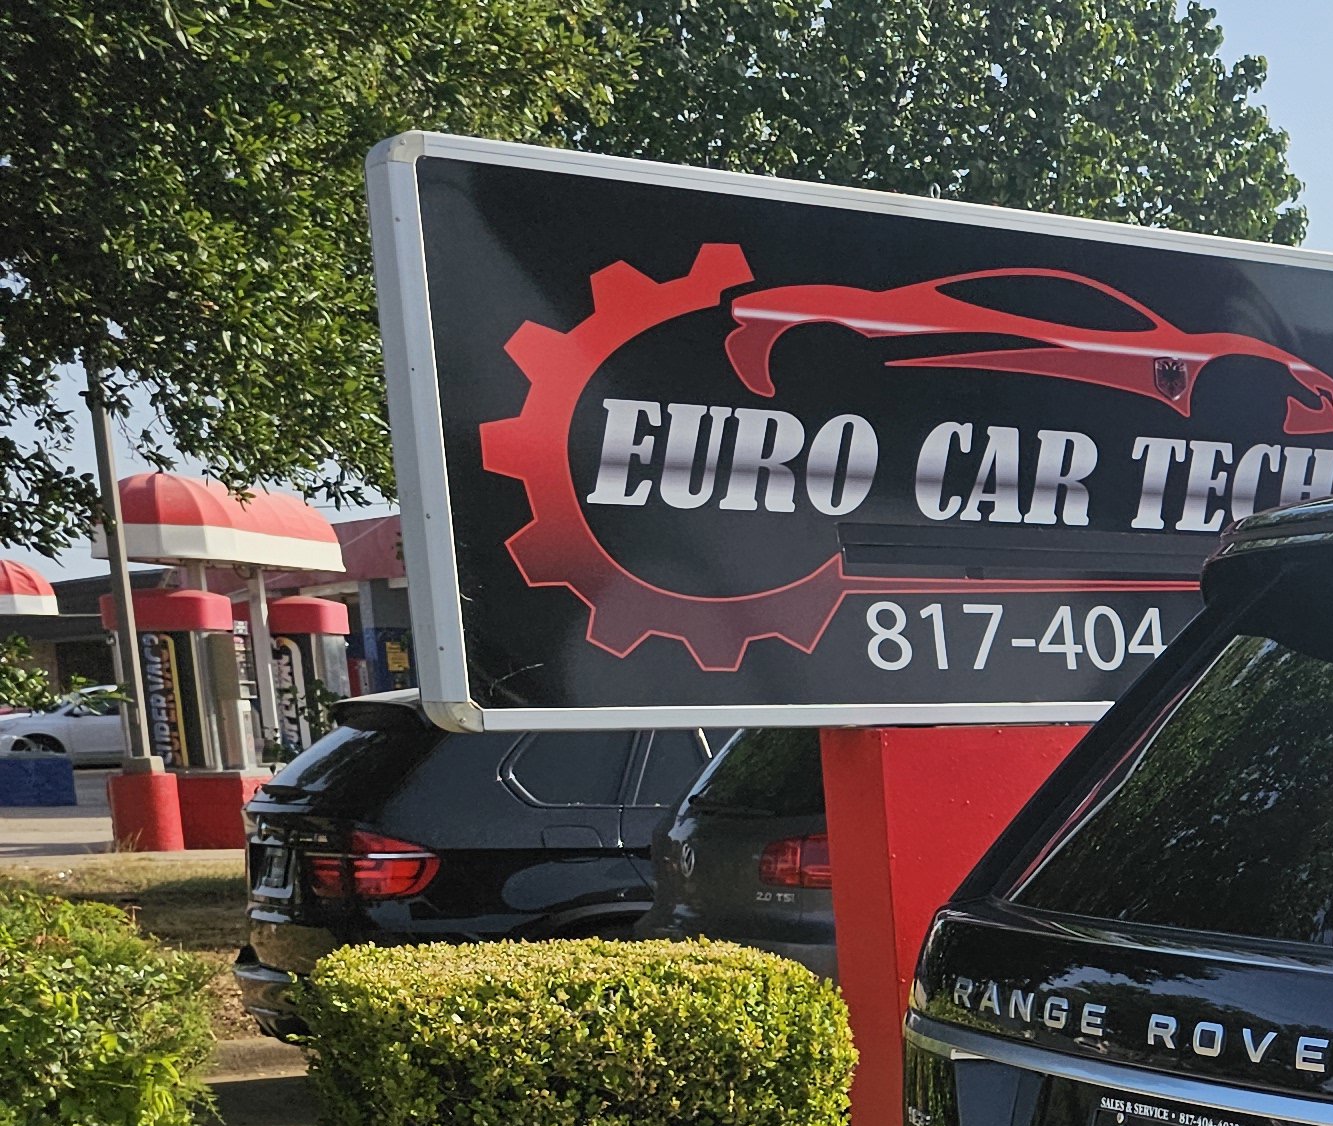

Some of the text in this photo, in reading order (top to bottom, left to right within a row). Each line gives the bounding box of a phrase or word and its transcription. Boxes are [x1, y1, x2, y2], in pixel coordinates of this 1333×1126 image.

[586, 398, 879, 516] EURO
[915, 421, 1098, 527] CAR
[953, 976, 1107, 1037] RANGE
[1100, 1096, 1125, 1113] SALES
[1125, 1101, 1133, 1113] &
[1133, 1102, 1169, 1121] SERVICE
